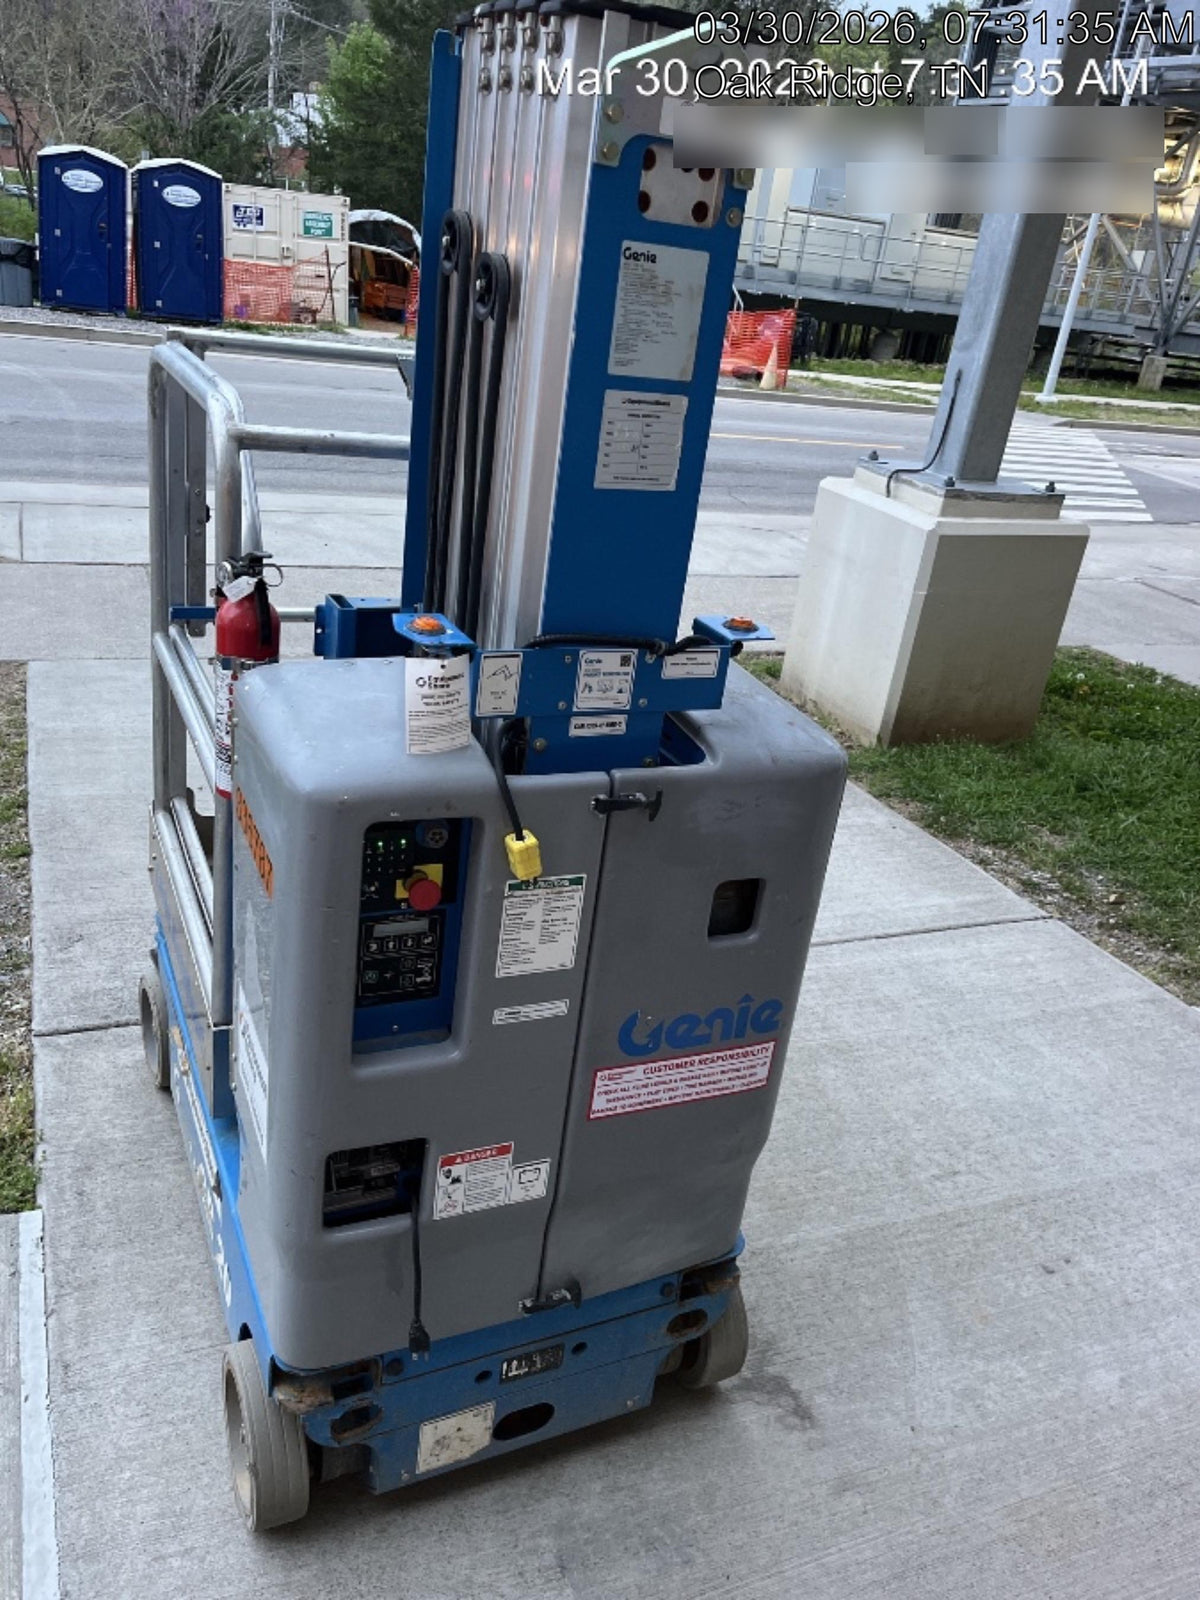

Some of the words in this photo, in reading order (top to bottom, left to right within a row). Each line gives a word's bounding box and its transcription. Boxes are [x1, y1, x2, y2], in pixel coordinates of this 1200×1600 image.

[623, 246, 657, 264] Genie
[618, 993, 784, 1057] Genie
[643, 1059, 696, 1075] CUSTOMER
[697, 1045, 770, 1066] RESPONSIBILITY
